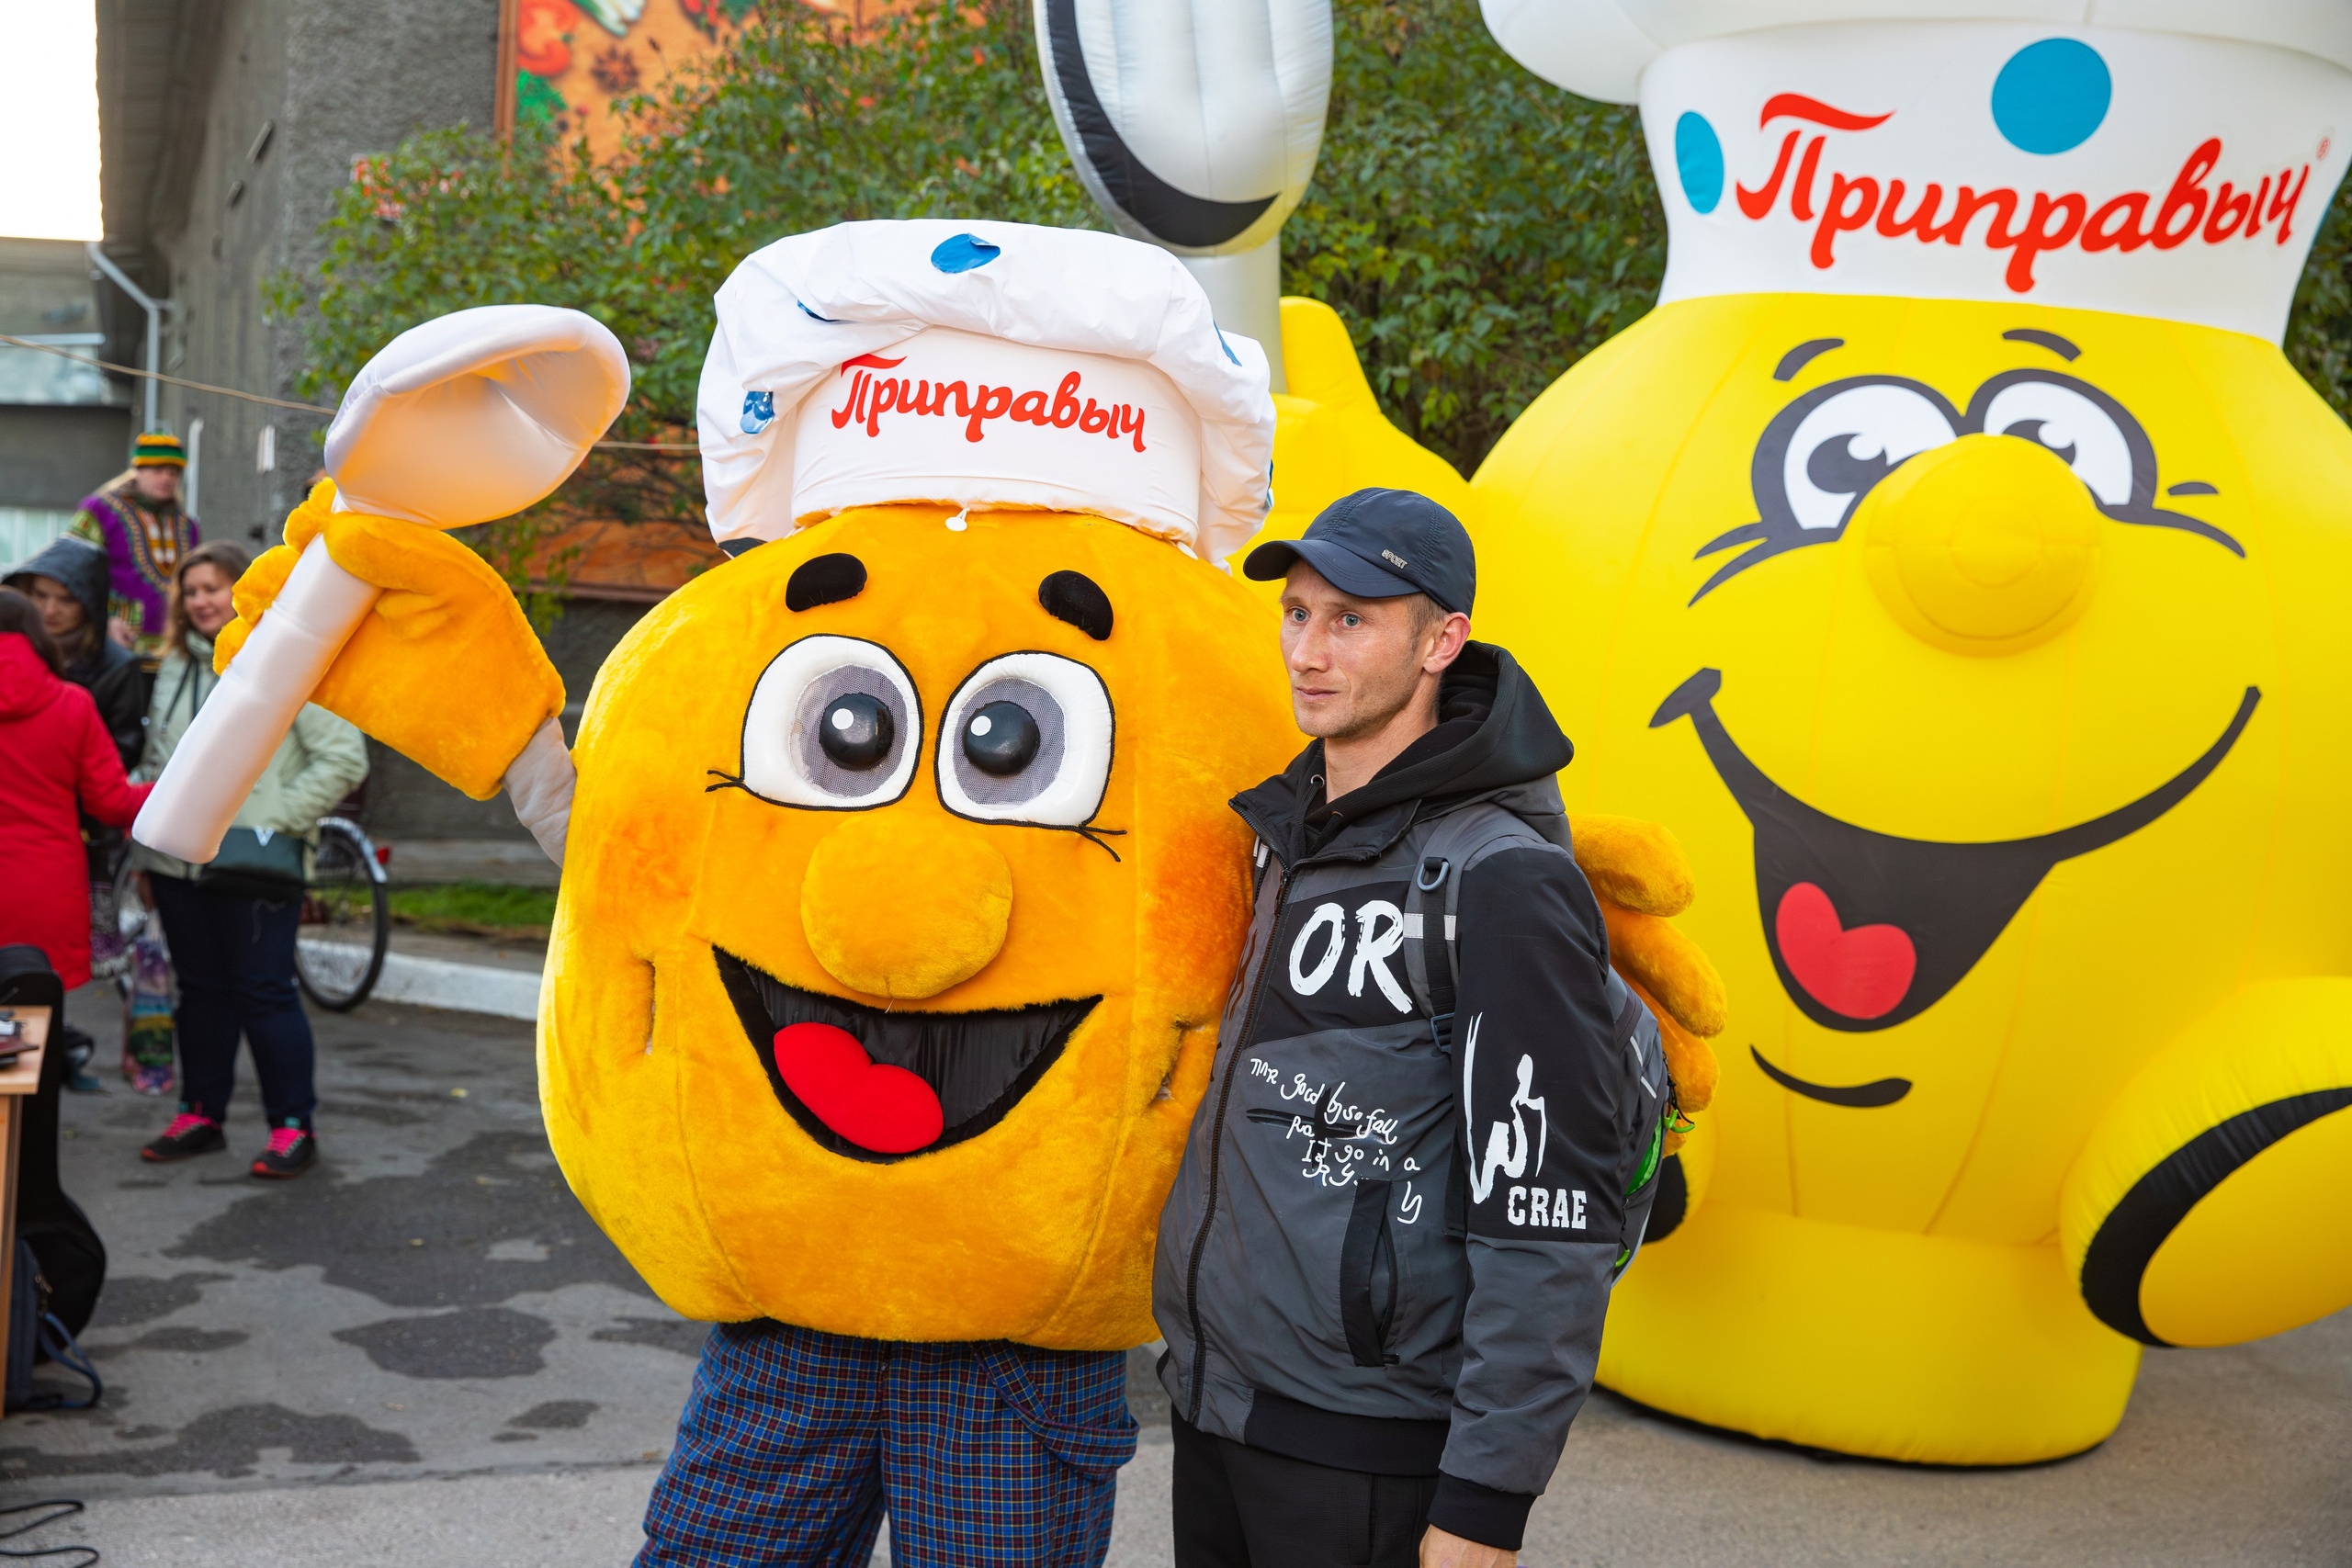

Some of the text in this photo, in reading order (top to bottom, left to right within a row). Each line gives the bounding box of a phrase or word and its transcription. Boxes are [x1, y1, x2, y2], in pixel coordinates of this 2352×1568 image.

[1736, 93, 2310, 293] Приправыч
[831, 353, 1148, 453] Приправыч
[1381, 548, 1408, 570] SPORT
[1508, 1186, 1588, 1230] CRAE
